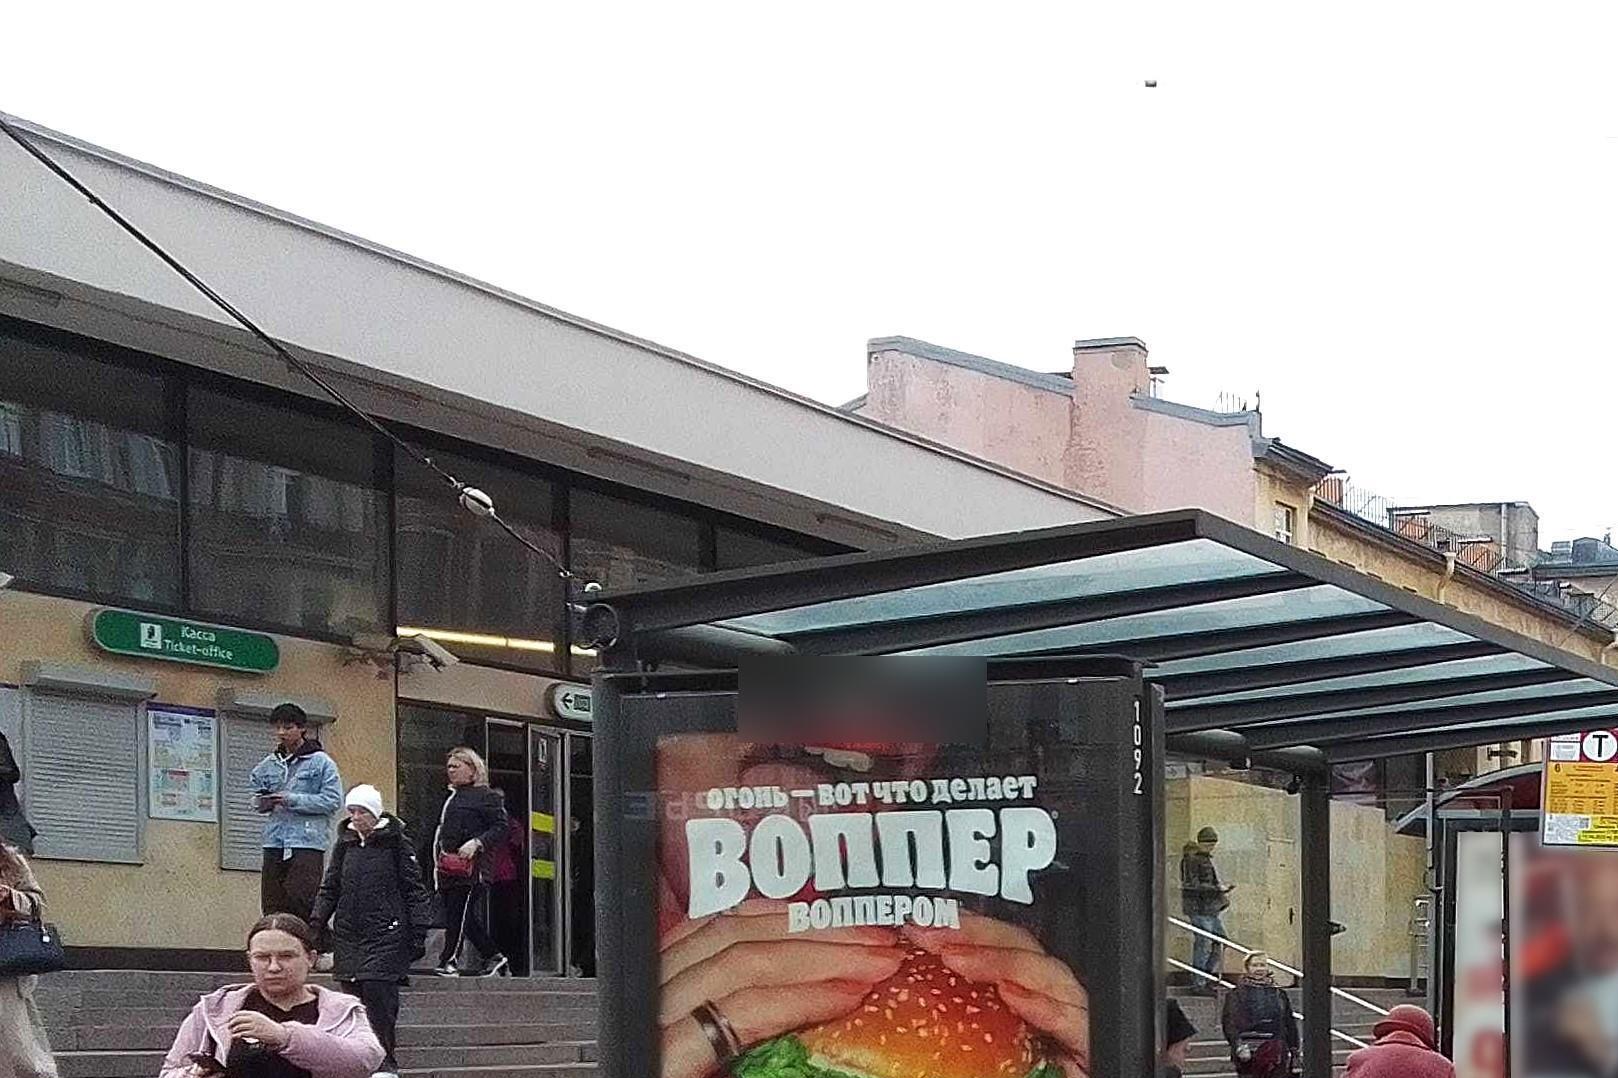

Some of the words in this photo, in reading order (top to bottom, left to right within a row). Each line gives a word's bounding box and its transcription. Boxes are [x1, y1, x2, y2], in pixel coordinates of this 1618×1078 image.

[181, 626, 216, 642] Касса
[163, 640, 234, 660] Ticket-office
[1134, 701, 1143, 795] 1092
[788, 895, 961, 933] ВОППЕРОМ
